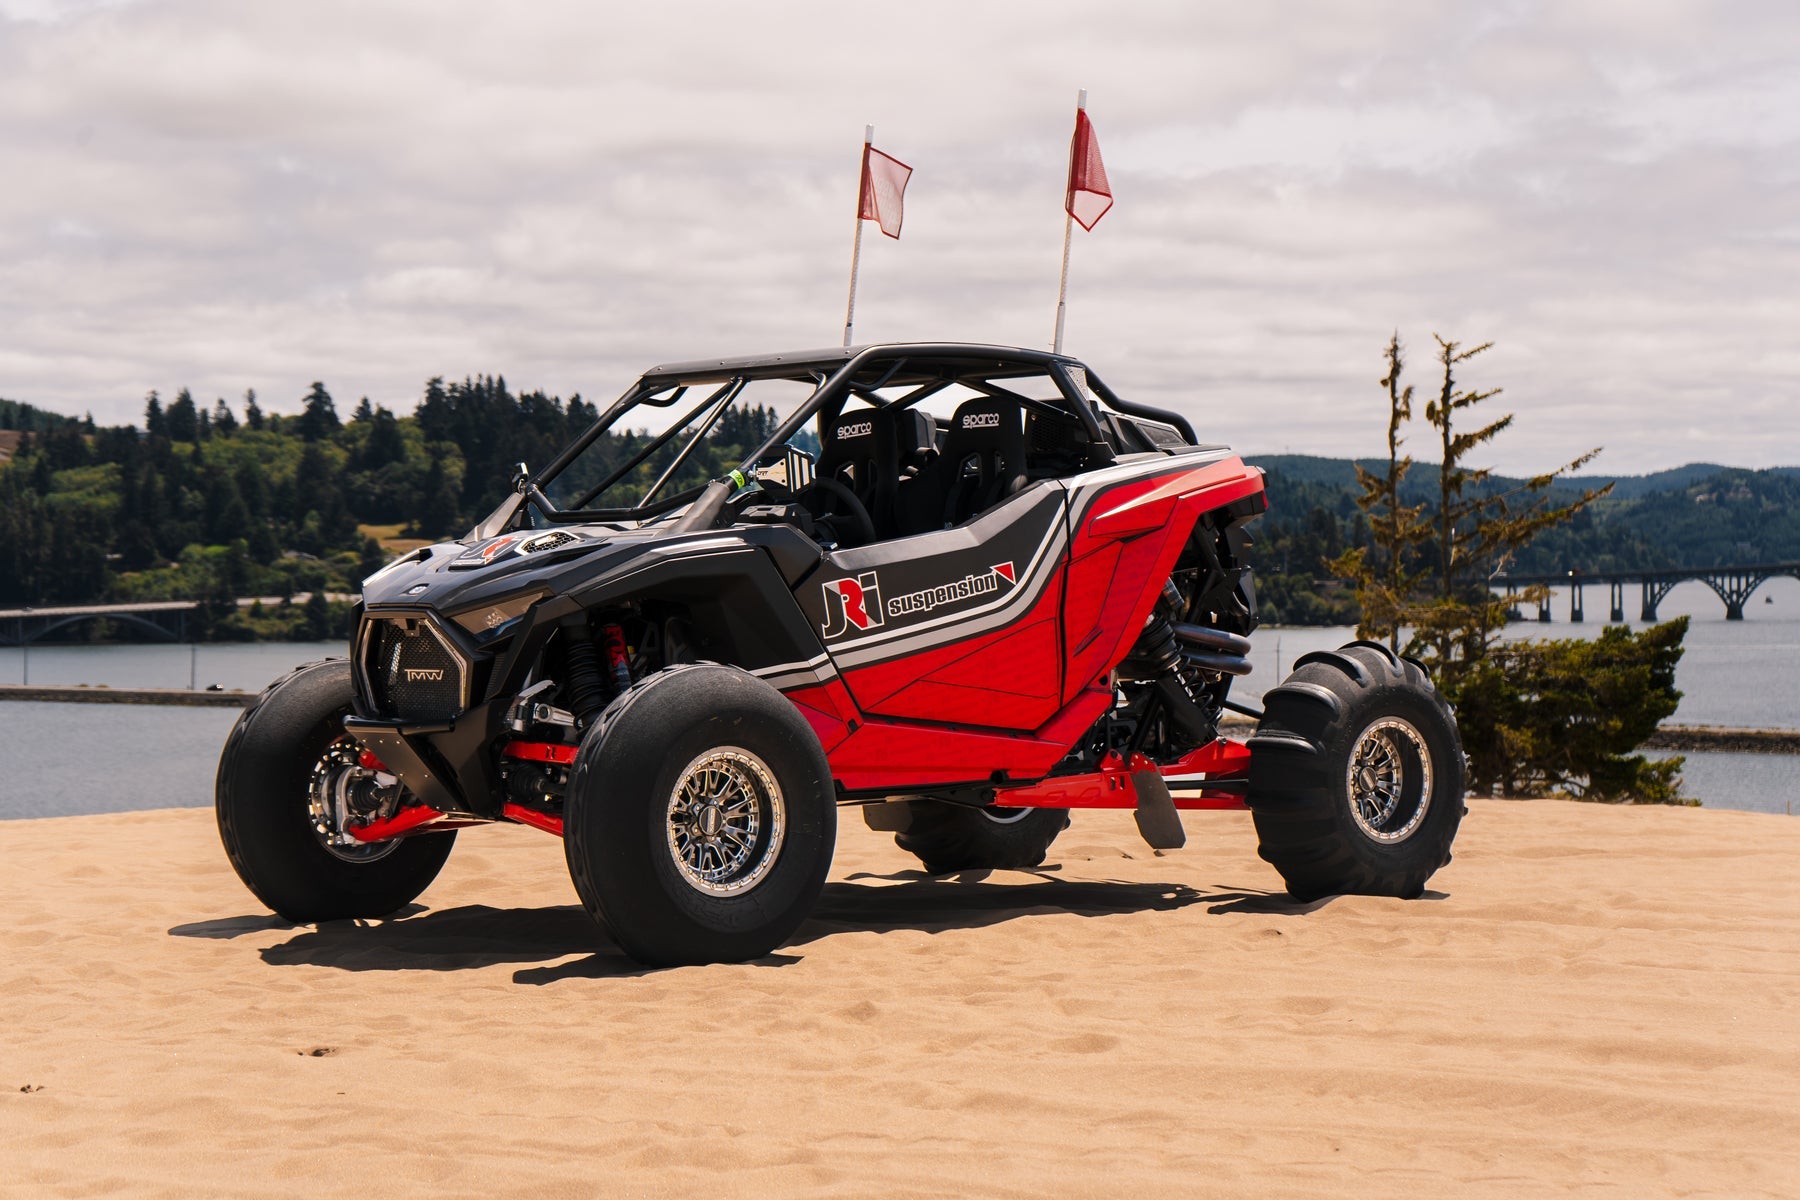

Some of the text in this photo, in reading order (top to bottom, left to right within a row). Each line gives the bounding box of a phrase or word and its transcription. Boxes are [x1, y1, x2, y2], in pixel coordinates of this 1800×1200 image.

[962, 412, 1000, 429] sparco
[837, 422, 872, 439] sparco
[888, 575, 998, 617] suspension
[404, 669, 444, 682] TMW
